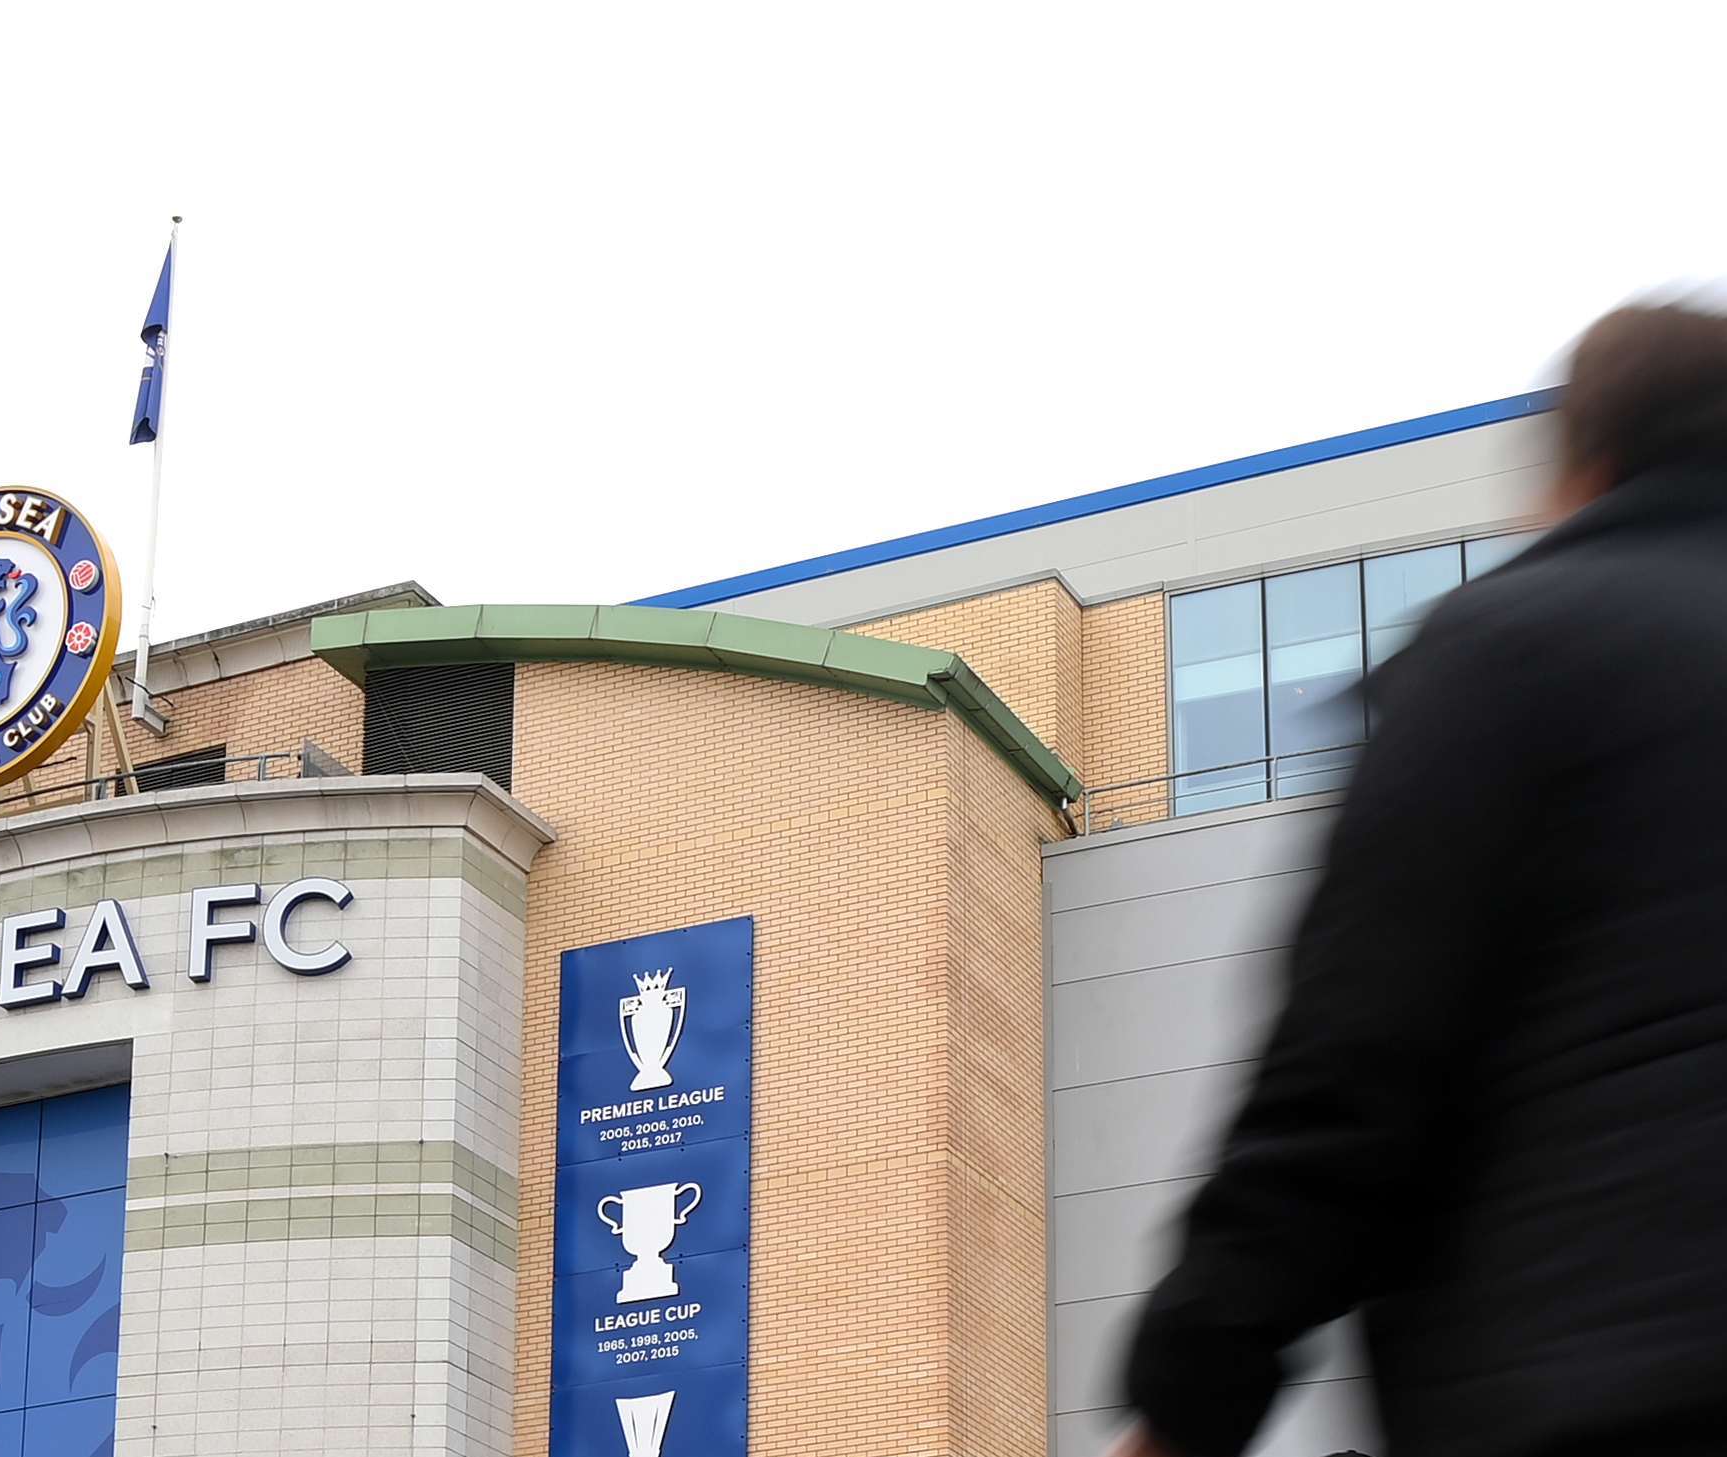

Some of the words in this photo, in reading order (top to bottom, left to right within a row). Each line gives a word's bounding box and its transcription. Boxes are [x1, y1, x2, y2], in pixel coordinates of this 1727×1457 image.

[3, 692, 61, 748] CLUB
[188, 877, 354, 983] FC
[580, 1099, 654, 1124] PREMIER
[658, 1086, 725, 1111] LEAGUE
[600, 1125, 633, 1141] 2005,
[636, 1120, 669, 1135] 2006,
[672, 1114, 704, 1129] 2010,
[621, 1138, 652, 1152] 2015,
[655, 1132, 682, 1146] 2017
[594, 1309, 660, 1332] LEAGUE
[665, 1303, 701, 1322] CUP
[597, 1339, 628, 1352] 1965,
[631, 1334, 661, 1348] 1998,
[664, 1329, 698, 1343] 2005,
[616, 1351, 649, 1364] 2007,
[650, 1346, 679, 1359] 2015
